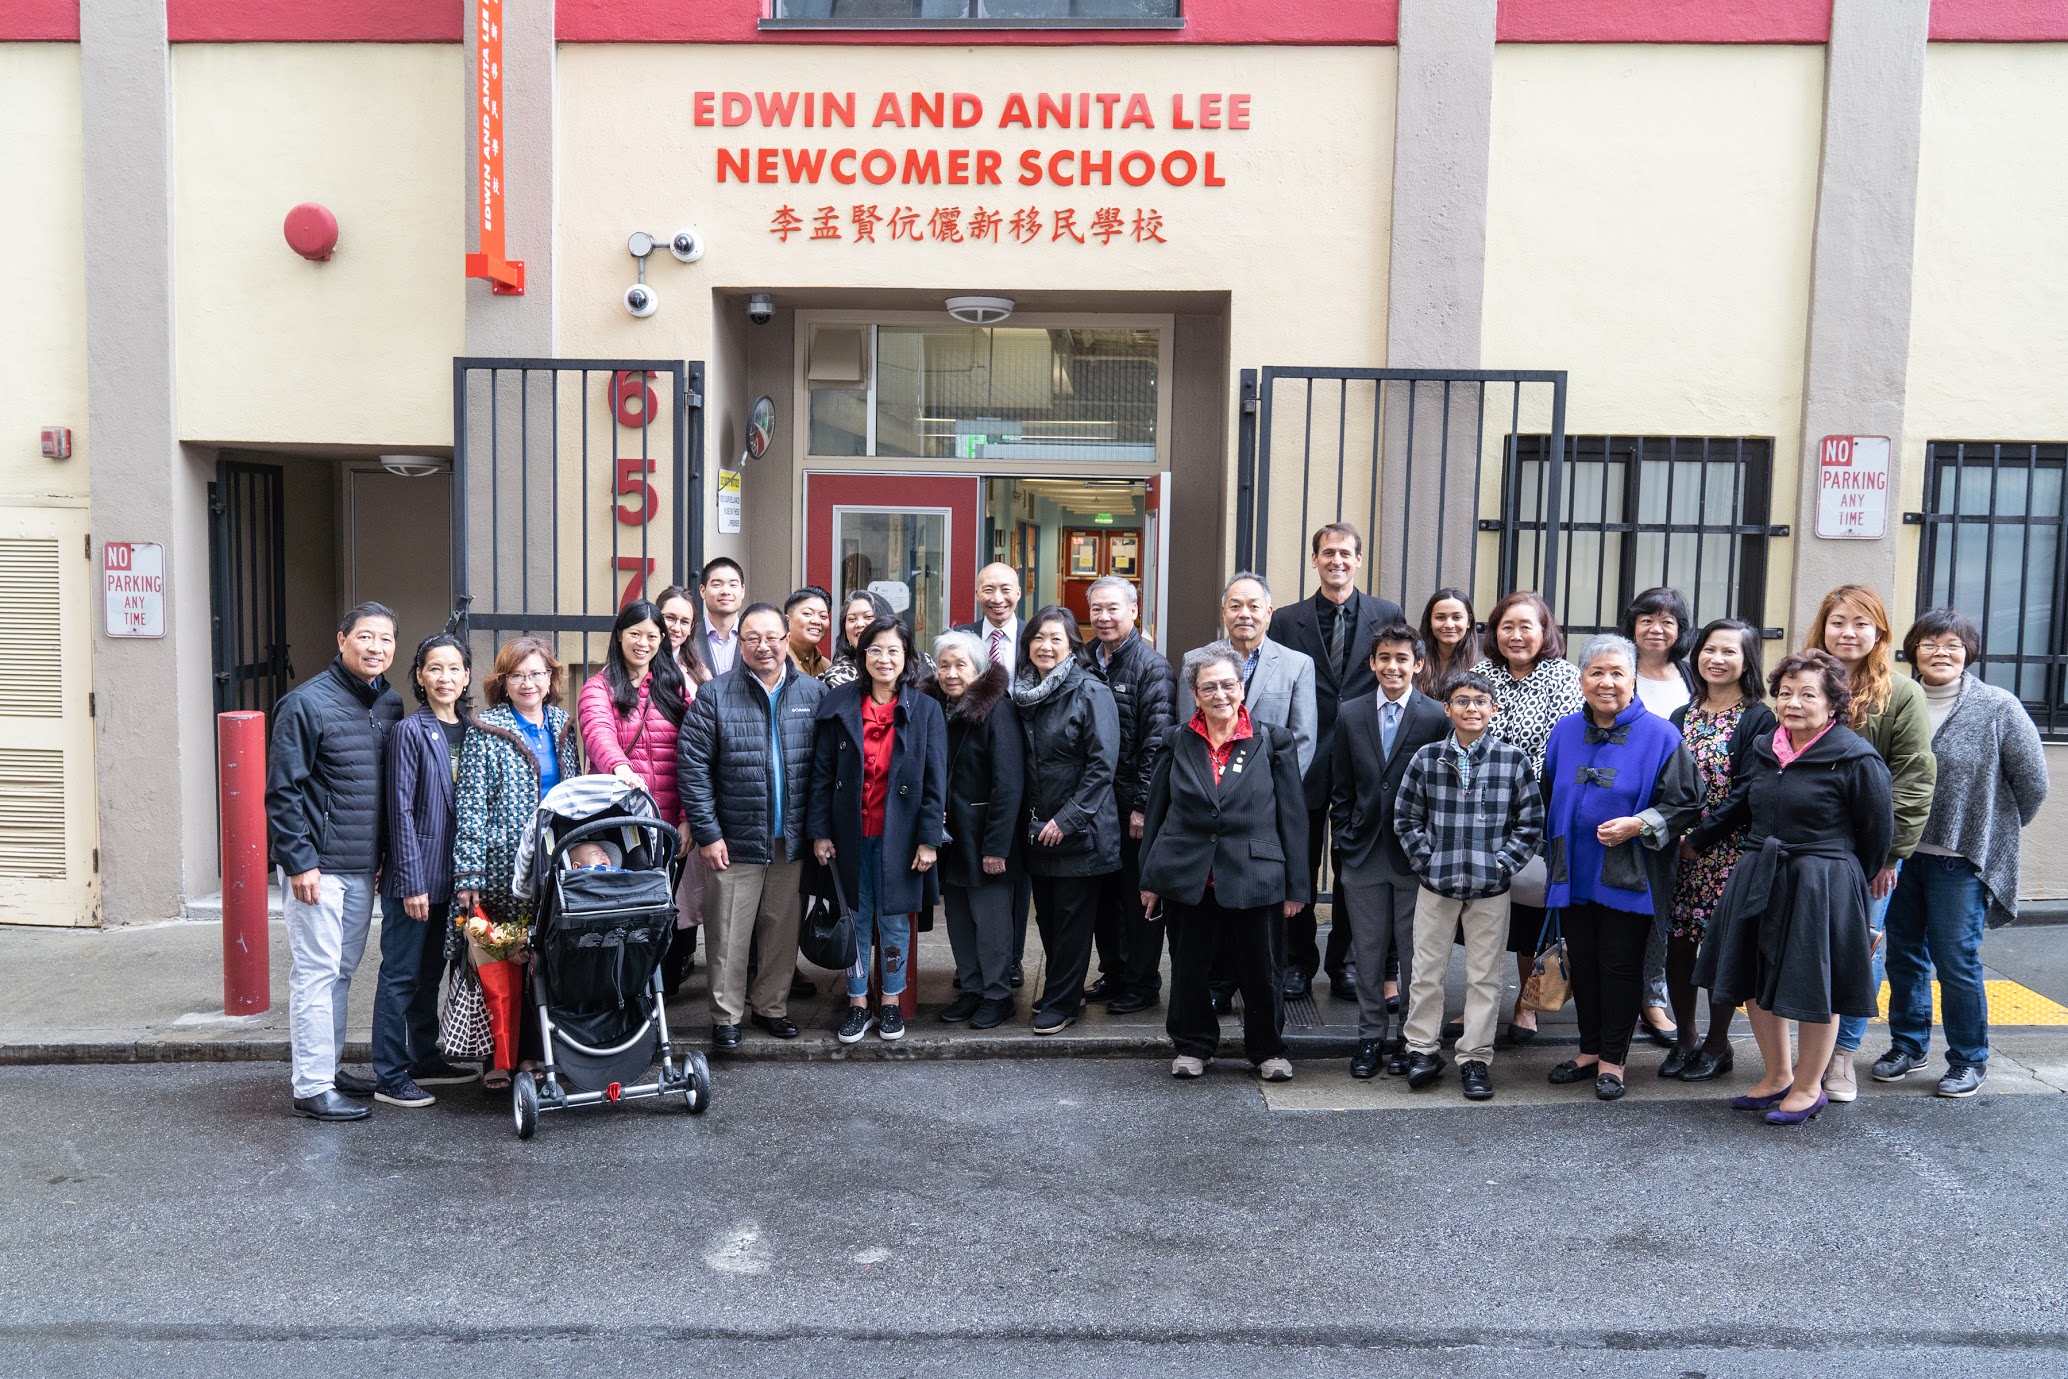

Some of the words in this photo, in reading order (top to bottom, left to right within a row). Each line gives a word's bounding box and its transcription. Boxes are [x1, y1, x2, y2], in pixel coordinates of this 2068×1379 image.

[482, 48, 490, 111] ANITA
[693, 91, 856, 128] EDWIN
[872, 92, 984, 129] AND
[999, 93, 1155, 129] ANITA
[1172, 94, 1252, 130] LEE
[483, 114, 491, 160] AND
[716, 147, 1003, 185] NEWCOMER
[1017, 149, 1226, 187] SCHOOL
[484, 163, 492, 231] EDWIN
[769, 203, 1168, 244] 李孟賢伉儷新移民學校
[1825, 439, 1850, 463] NO
[1823, 470, 1886, 490] PARKING
[1840, 493, 1865, 508] ANY
[1839, 511, 1865, 526] TIME
[107, 546, 128, 567] NO
[107, 574, 161, 593] PARKING
[124, 595, 145, 609] ANY
[124, 612, 146, 626] TIME
